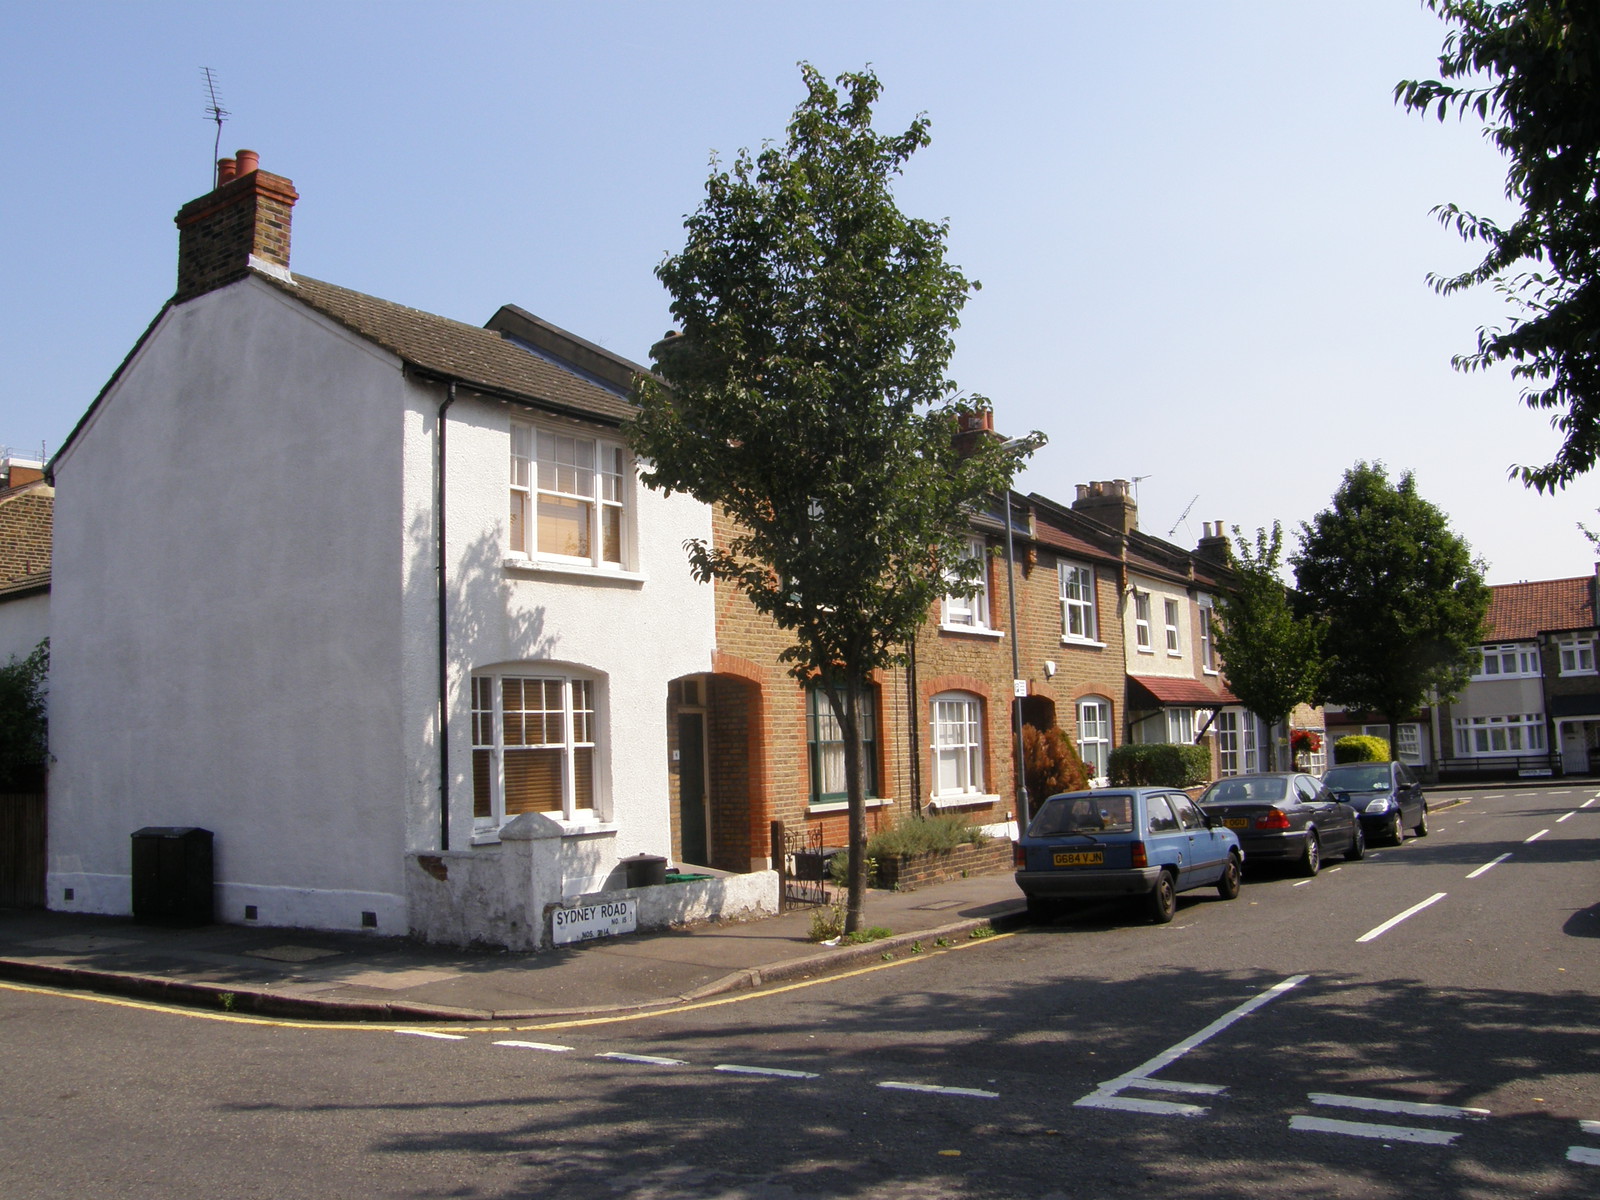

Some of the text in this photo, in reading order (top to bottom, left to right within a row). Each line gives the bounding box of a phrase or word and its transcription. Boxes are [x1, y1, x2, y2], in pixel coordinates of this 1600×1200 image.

[1055, 852, 1102, 864] G684 VJN
[557, 903, 626, 925] SYDNEY ROAD
